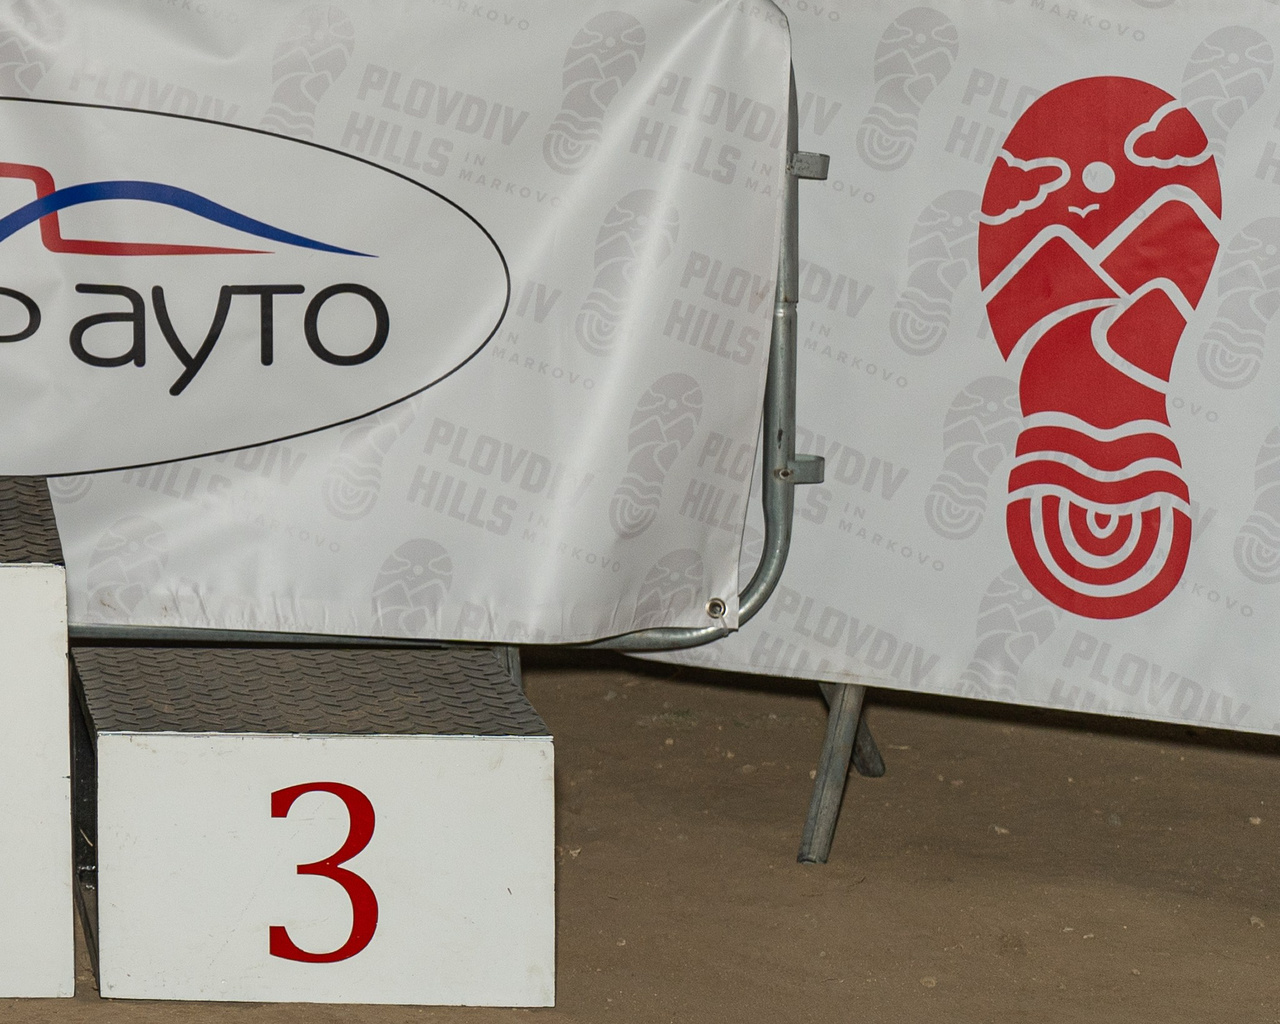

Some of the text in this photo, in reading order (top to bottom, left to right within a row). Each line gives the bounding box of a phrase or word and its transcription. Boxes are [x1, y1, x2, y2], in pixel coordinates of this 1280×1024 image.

[357, 63, 530, 146] PLOVDIV
[340, 111, 454, 176] HILLS
[465, 152, 486, 167] IN
[751, 159, 773, 177] IN
[459, 168, 565, 207] MARKOVO
[497, 330, 519, 345] IN
[663, 298, 760, 366] HILLS
[810, 321, 831, 337] IN
[492, 346, 595, 391] MARKOVO
[804, 336, 910, 390] MARKOVO
[407, 465, 518, 536] HILLS
[843, 502, 866, 520] IN
[839, 519, 945, 572] MARKOVO
[770, 584, 940, 688] PLOVDIV
[1062, 629, 1251, 727] PLOVDIV
[268, 782, 379, 964] 3
